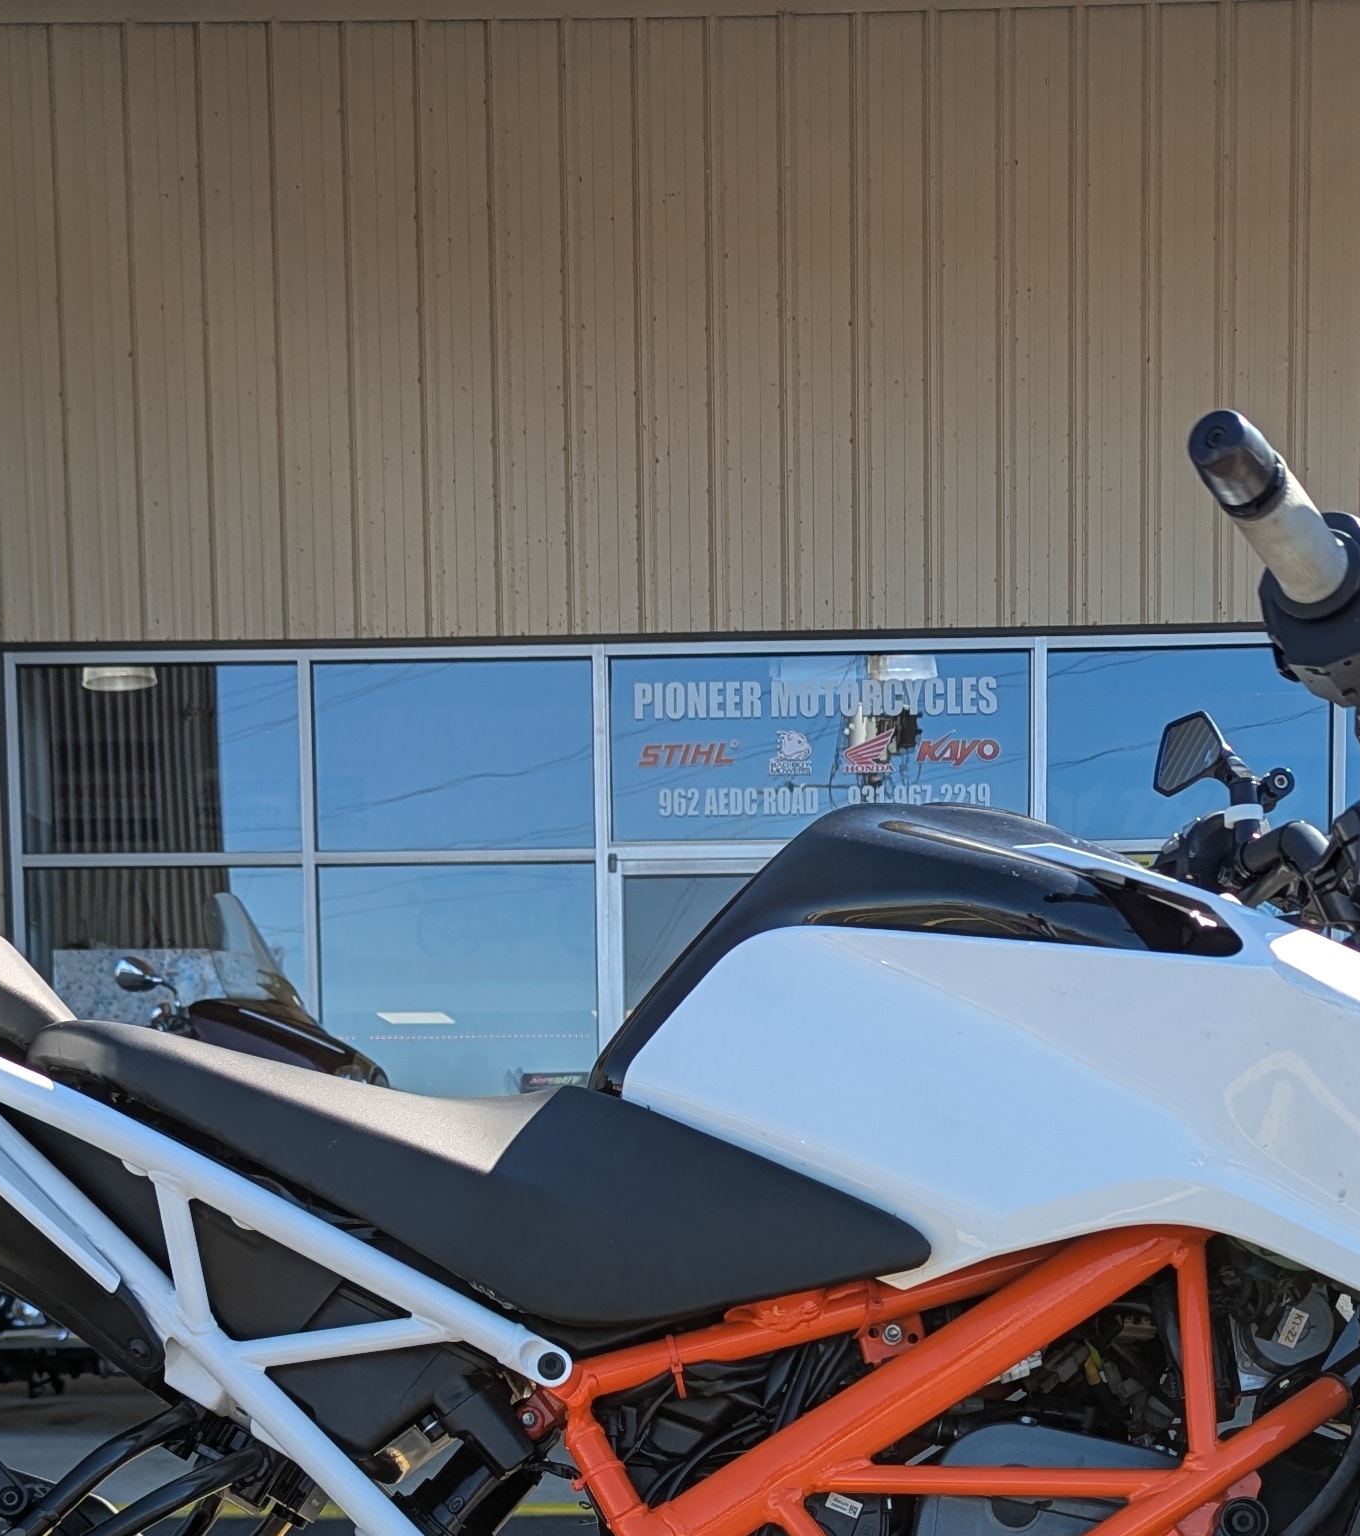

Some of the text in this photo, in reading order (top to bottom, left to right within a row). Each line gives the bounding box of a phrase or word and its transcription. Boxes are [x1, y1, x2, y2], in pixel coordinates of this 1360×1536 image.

[634, 676, 998, 720] PIONEER MOTORCYCLES
[639, 743, 735, 768] STIHL
[916, 729, 1001, 768] KAYO
[845, 765, 895, 773] HONDA
[659, 783, 991, 817] 962 AEDC ROAD 931-967-2219
